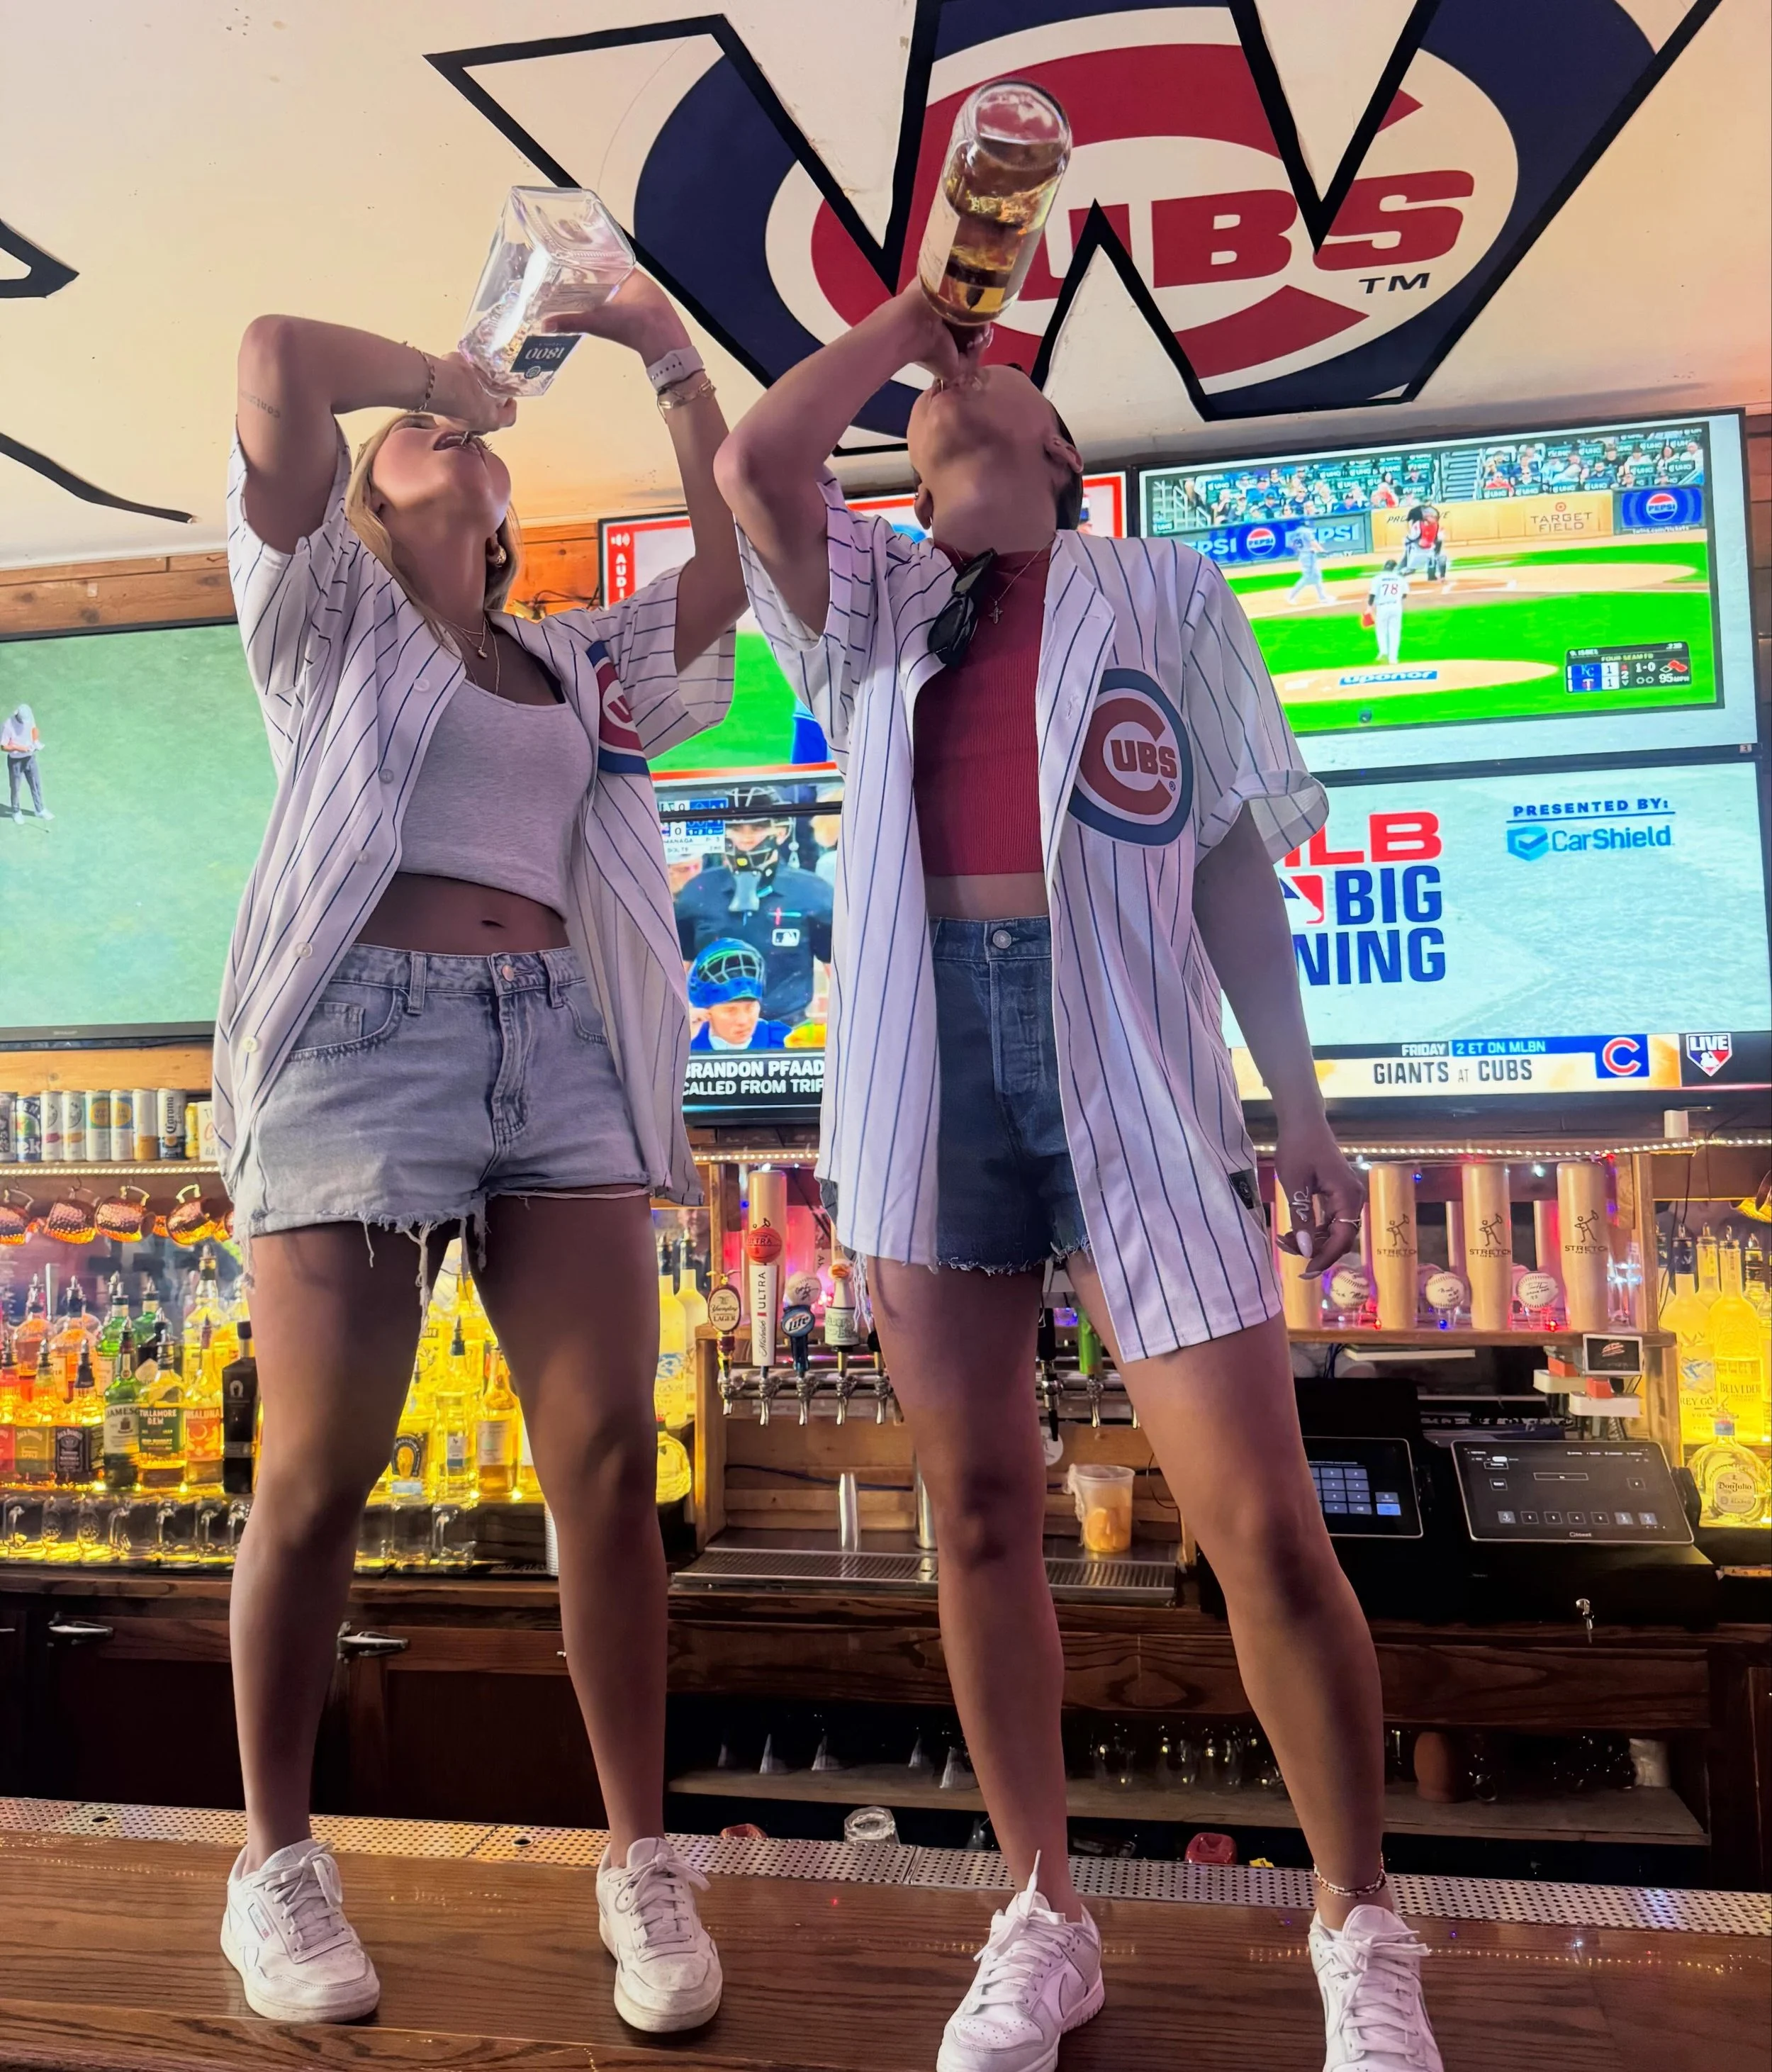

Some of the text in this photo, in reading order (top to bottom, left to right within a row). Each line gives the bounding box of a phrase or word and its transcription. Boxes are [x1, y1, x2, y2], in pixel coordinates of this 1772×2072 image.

[1359, 272, 1430, 294] TM
[525, 347, 565, 361] 1800
[1648, 503, 1676, 512] PEPSI
[1530, 512, 1593, 524] TARGET
[1539, 522, 1585, 532] FIELD
[1183, 538, 1238, 556] PSI
[1381, 583, 1398, 595] 78
[1342, 671, 1433, 684] uponor
[1621, 671, 1629, 679] 2
[1513, 797, 1669, 817] PRESENTED BY:
[1285, 812, 1442, 867] LB
[1552, 824, 1671, 852] CarShield
[1335, 866, 1442, 925] BIG
[1401, 1043, 1446, 1056] FRIDAY
[1457, 1040, 1547, 1055] 2 ET ON MLBN
[1690, 1036, 1728, 1051] LIVE
[1602, 1037, 1641, 1076] C
[1374, 1059, 1533, 1085] GIANTS AT CUBS
[741, 1079, 787, 1094] FROM
[165, 1096, 176, 1134] Corona
[758, 1272, 766, 1309] ULTRA
[788, 1316, 809, 1332] Lite
[139, 1409, 177, 1418] TULLAMORE
